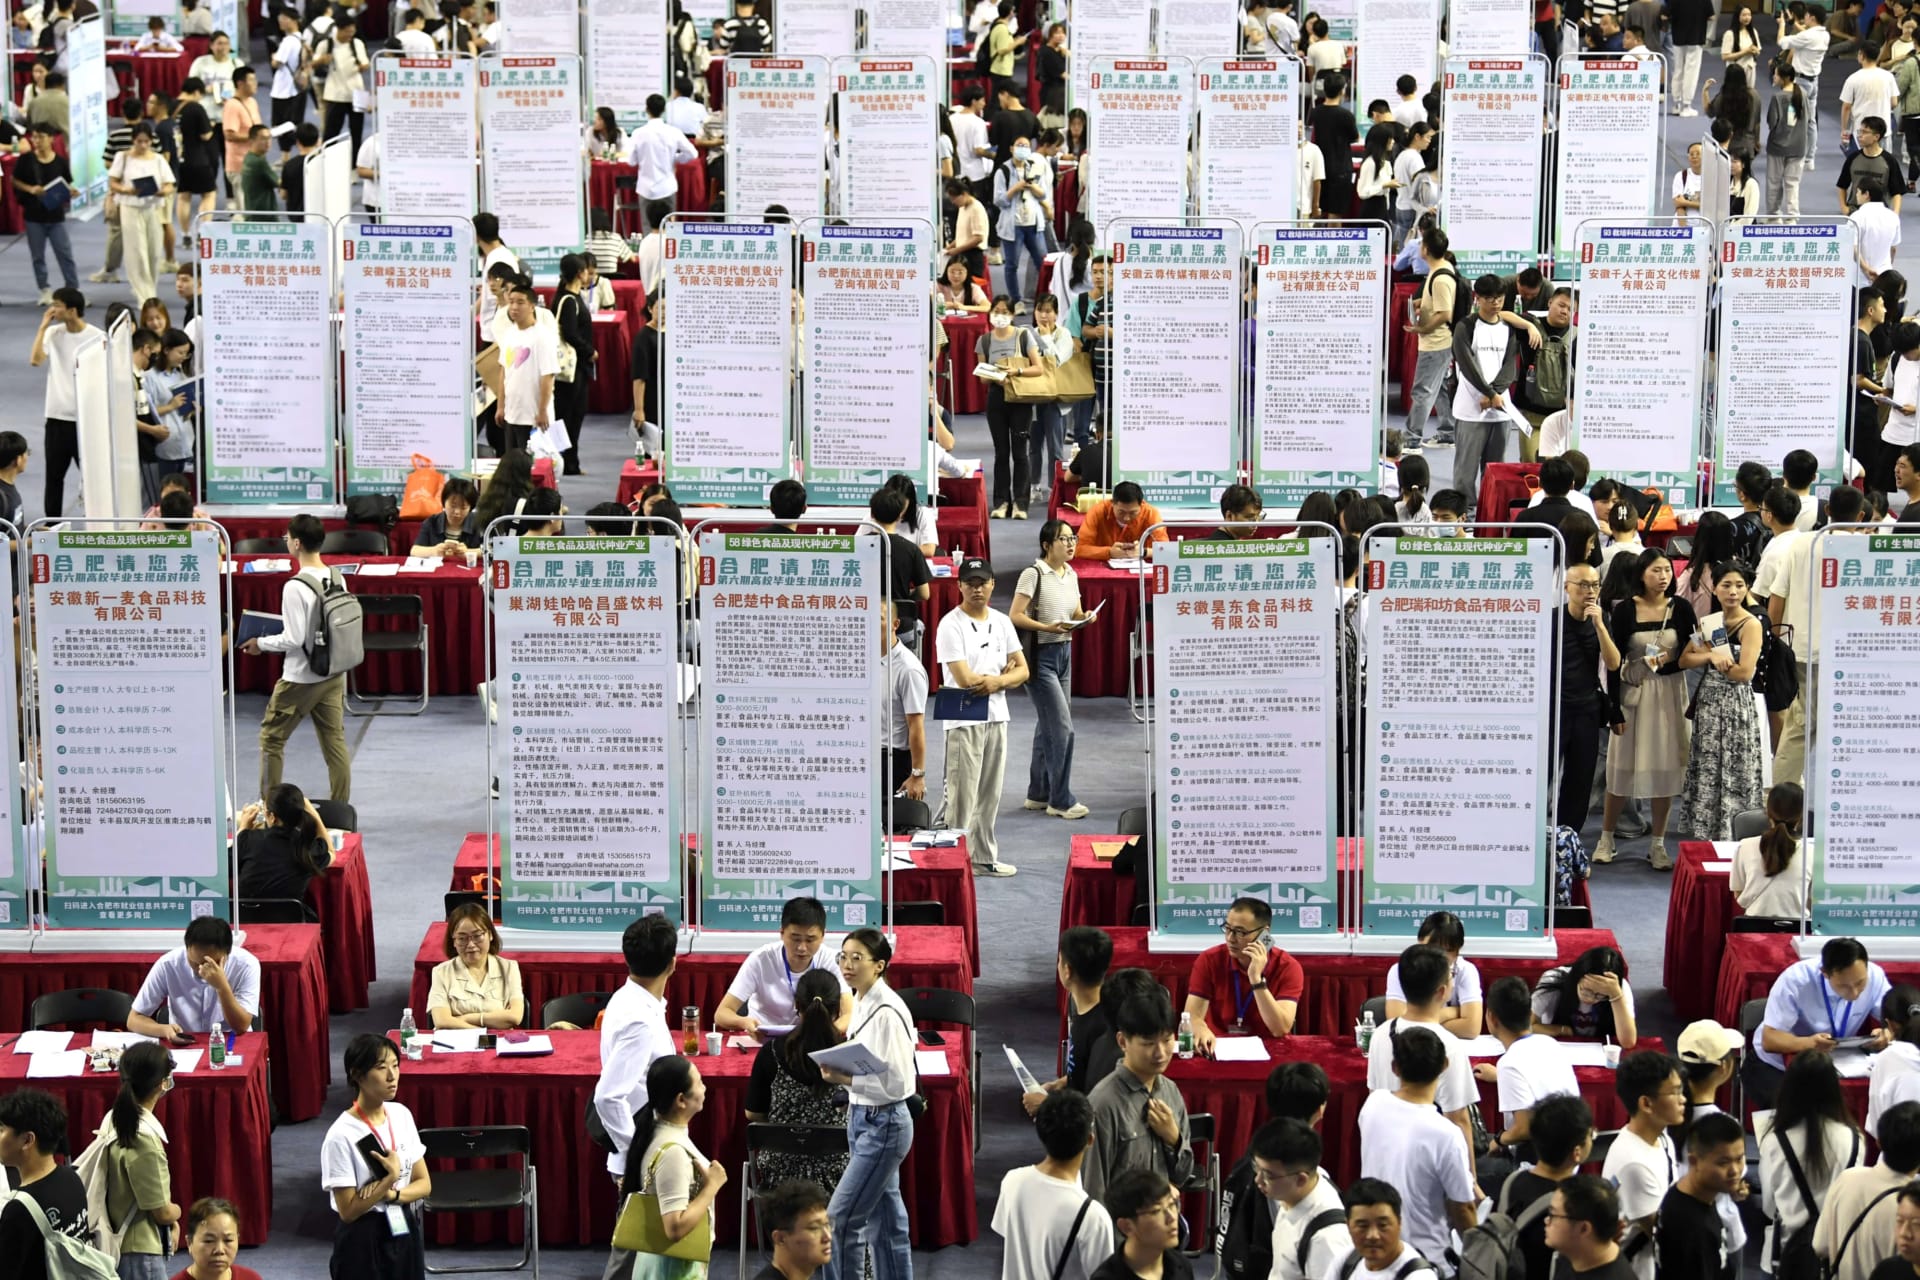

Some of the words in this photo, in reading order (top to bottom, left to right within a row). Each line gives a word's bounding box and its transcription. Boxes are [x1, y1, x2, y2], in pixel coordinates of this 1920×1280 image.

[514, 99, 548, 107] 有限公司
[760, 101, 794, 109] 有限公司
[1102, 102, 1179, 111] 有限公司合肥分公司
[1233, 103, 1267, 111] 有限公司
[1477, 102, 1512, 110] 有限公司
[214, 239, 314, 252] 合肥请您来
[357, 241, 456, 254] 合肥请您来
[679, 240, 778, 253] 合肥请您来
[818, 242, 917, 255] 合肥请您来
[1127, 243, 1226, 256] 合肥请您来
[1272, 245, 1371, 257] 合肥请您来
[1596, 242, 1696, 256] 合肥请您来
[1738, 241, 1840, 254] 合肥请您来
[673, 264, 784, 276] 北京天奕时代创意设计
[817, 268, 917, 279] 合肥新航道前程留学
[1122, 269, 1232, 280] 安徽云尊传媒有限公司
[1266, 270, 1377, 281] 中国科学技术大学出版
[1589, 269, 1700, 280] 安徽千人千面文化传媒
[1731, 267, 1845, 279] 安徽之达大数据研究院
[244, 277, 288, 286] 有限公司
[385, 278, 429, 288] 有限公司
[679, 277, 778, 288] 有限公司安徽分公司
[834, 279, 900, 290] 咨询有限公司
[1283, 281, 1359, 292] 社有限责任公司
[1622, 280, 1667, 291] 有限公司
[1765, 279, 1810, 289] 有限公司
[63, 535, 74, 544] 56
[76, 535, 187, 544] 绿色食品及现代种业产业
[523, 541, 534, 550] 57
[536, 540, 646, 550] 绿色食品及现代种业产业
[729, 538, 740, 547] 58
[742, 537, 850, 549] 绿色食品及现代种业产业
[1875, 540, 1887, 548] 61
[1183, 545, 1194, 554] 59
[1196, 543, 1305, 554] 绿色食品及现代种业产业
[1400, 542, 1411, 551] 60
[1413, 542, 1523, 552] 绿色食品及现代种业产业
[54, 554, 198, 572] 合肥请您来
[514, 560, 656, 577] 合肥请您来
[720, 557, 861, 576] 合肥请您来
[1173, 562, 1315, 582] 合肥请您来
[1389, 561, 1533, 579] 合肥请您来
[52, 573, 200, 583] 第六期高校毕业生现场对接会
[512, 578, 658, 588] 第六期高校毕业生现场对接会
[717, 575, 862, 587] 第六期高校毕业生现场对接会
[1172, 580, 1317, 593] 第六期高校毕业生现场对接会
[1387, 580, 1534, 590] 第六期高校毕业生现场对接会
[50, 591, 206, 605] 安徽新一麦食品科技
[510, 596, 663, 611] 巢湖娃哈哈昌盛饮料
[713, 594, 868, 610] 合肥楚中食品有限公司
[1176, 598, 1313, 615] 安徽昊东食品科技
[1380, 597, 1541, 613] 合肥瑞和坊食品有限公司
[95, 607, 162, 621] 有限公司
[553, 612, 619, 627] 有限公司
[1212, 616, 1279, 630] 有限公司
[1380, 775, 1452, 783] 品加工技术等相关专业
[816, 791, 866, 799] 本科及本科以上
[64, 902, 185, 911] 扫码进入合肥市就业信息共享平台
[518, 907, 636, 915] 扫码进入合肥市就业信息共享平台
[719, 904, 837, 913] 扫码进入合肥市就平台
[100, 910, 151, 919] 查看更多岗位
